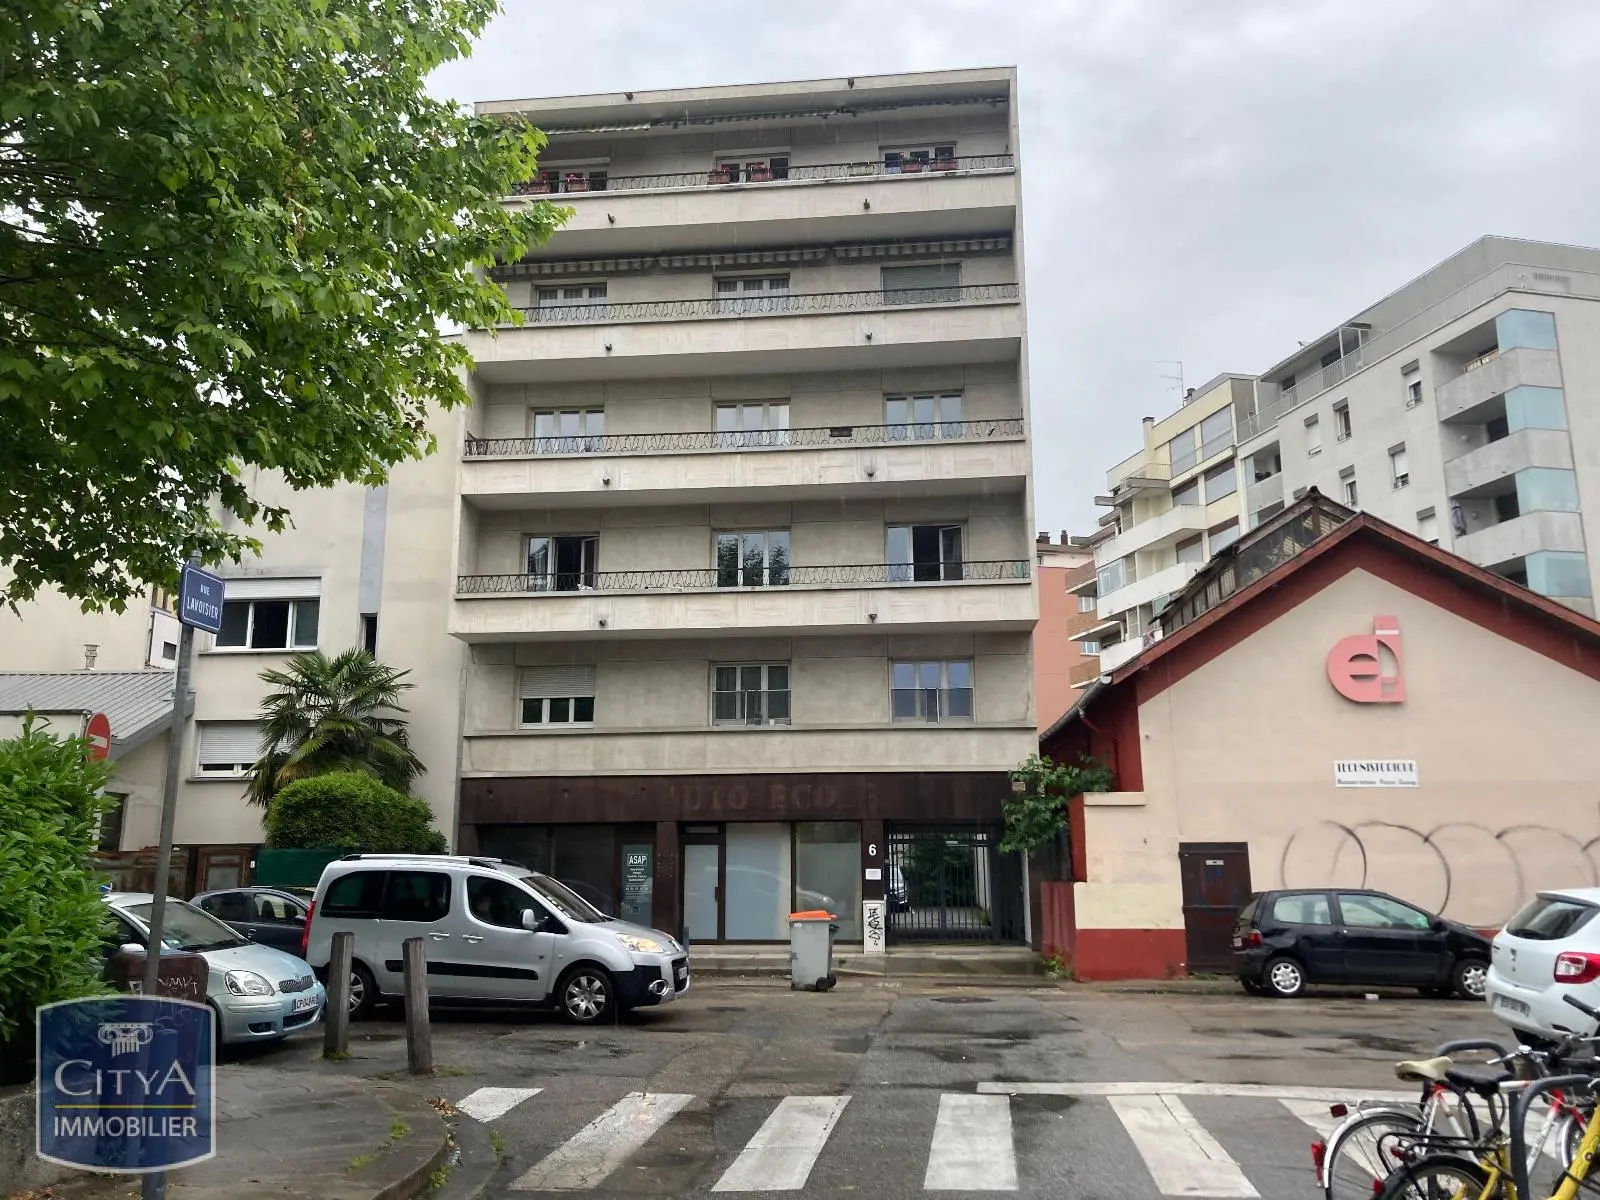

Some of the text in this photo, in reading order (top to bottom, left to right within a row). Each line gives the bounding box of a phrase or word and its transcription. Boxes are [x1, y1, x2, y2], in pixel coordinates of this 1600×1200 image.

[200, 584, 210, 596] RUE
[186, 596, 219, 620] LAVOISIER
[868, 844, 877, 856] 6
[628, 855, 647, 865] ASAP
